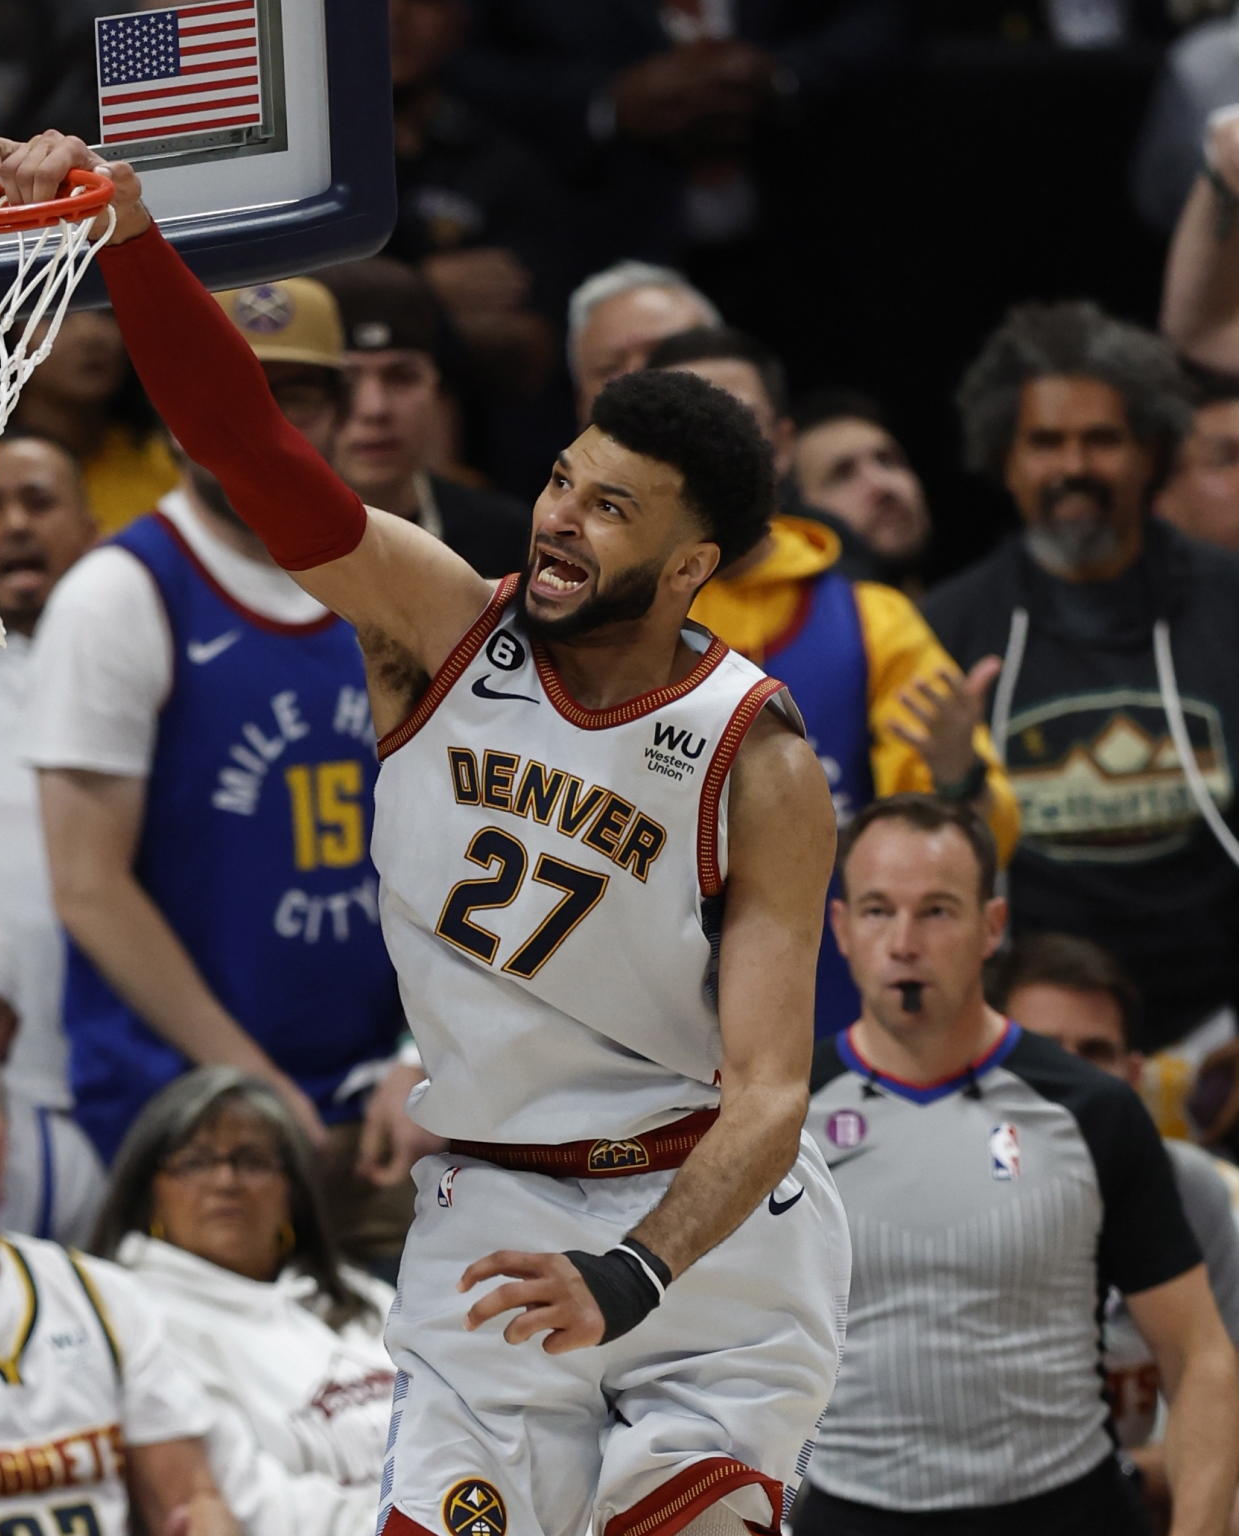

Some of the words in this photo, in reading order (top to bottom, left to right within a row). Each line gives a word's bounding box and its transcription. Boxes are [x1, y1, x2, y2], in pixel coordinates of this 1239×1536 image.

[492, 634, 515, 665] 6
[212, 690, 311, 816] MILE
[644, 747, 695, 775] Western
[647, 760, 683, 781] Union
[653, 722, 707, 759] WU
[284, 760, 365, 871] 15
[447, 746, 667, 884] DENVER
[434, 826, 610, 980] 27
